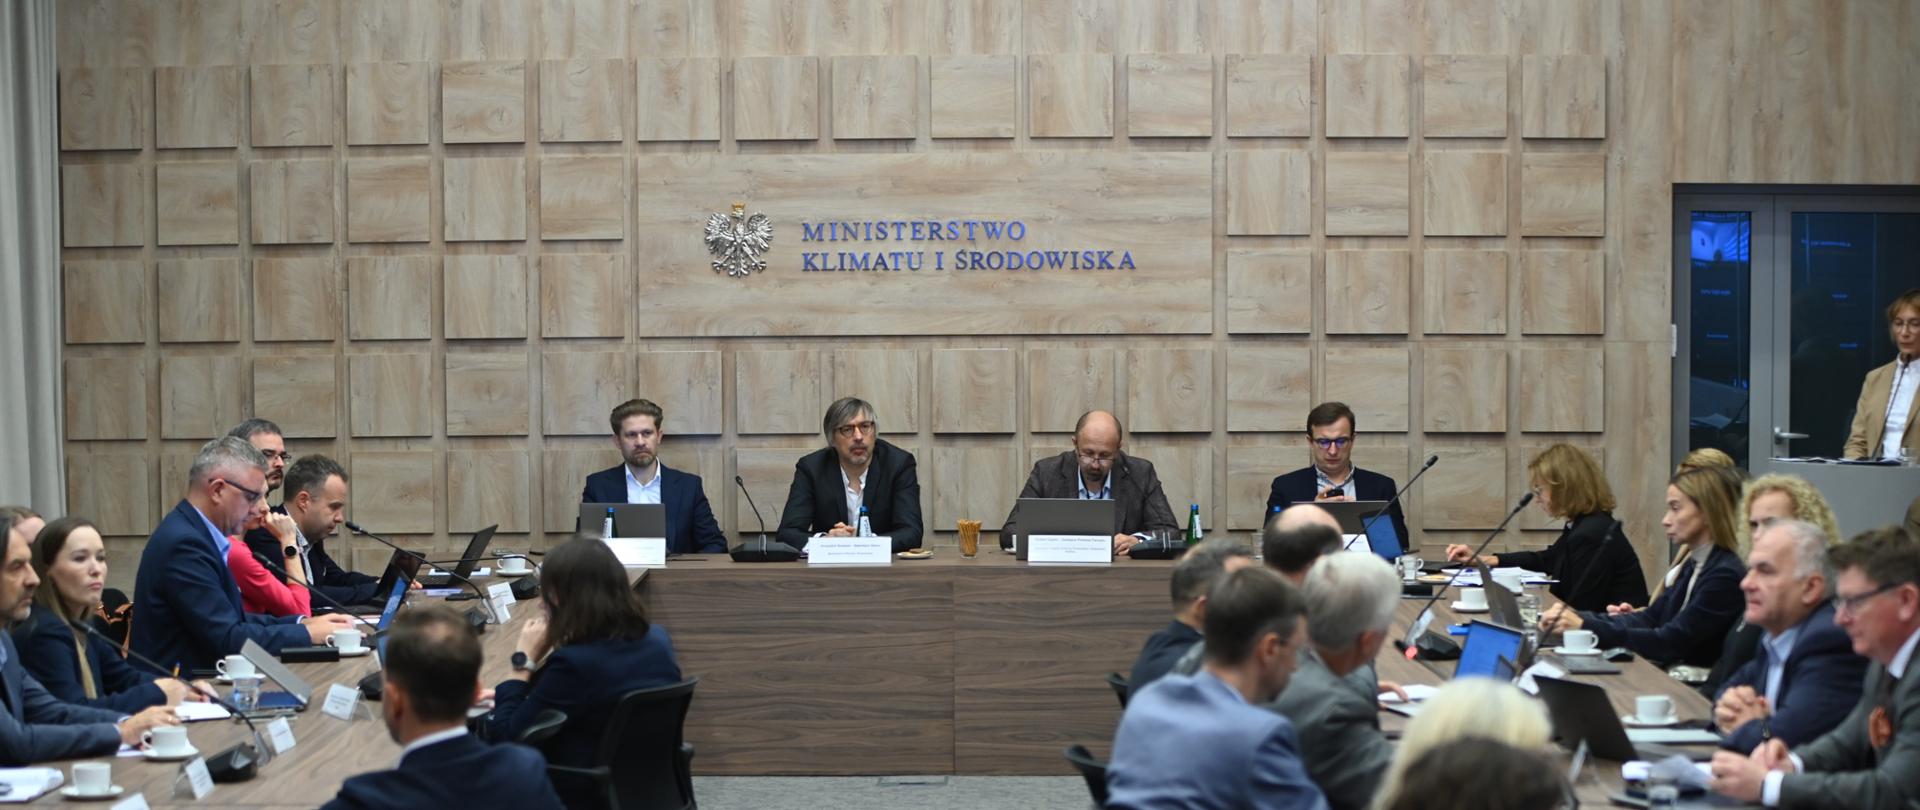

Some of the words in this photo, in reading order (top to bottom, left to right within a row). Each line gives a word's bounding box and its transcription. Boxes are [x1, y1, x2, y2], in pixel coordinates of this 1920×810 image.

[801, 219, 1027, 242] MINISTERSTWO
[801, 251, 926, 272] KLIMATU
[934, 250, 945, 271] I
[954, 247, 1137, 271] ŚRODOWISKA
